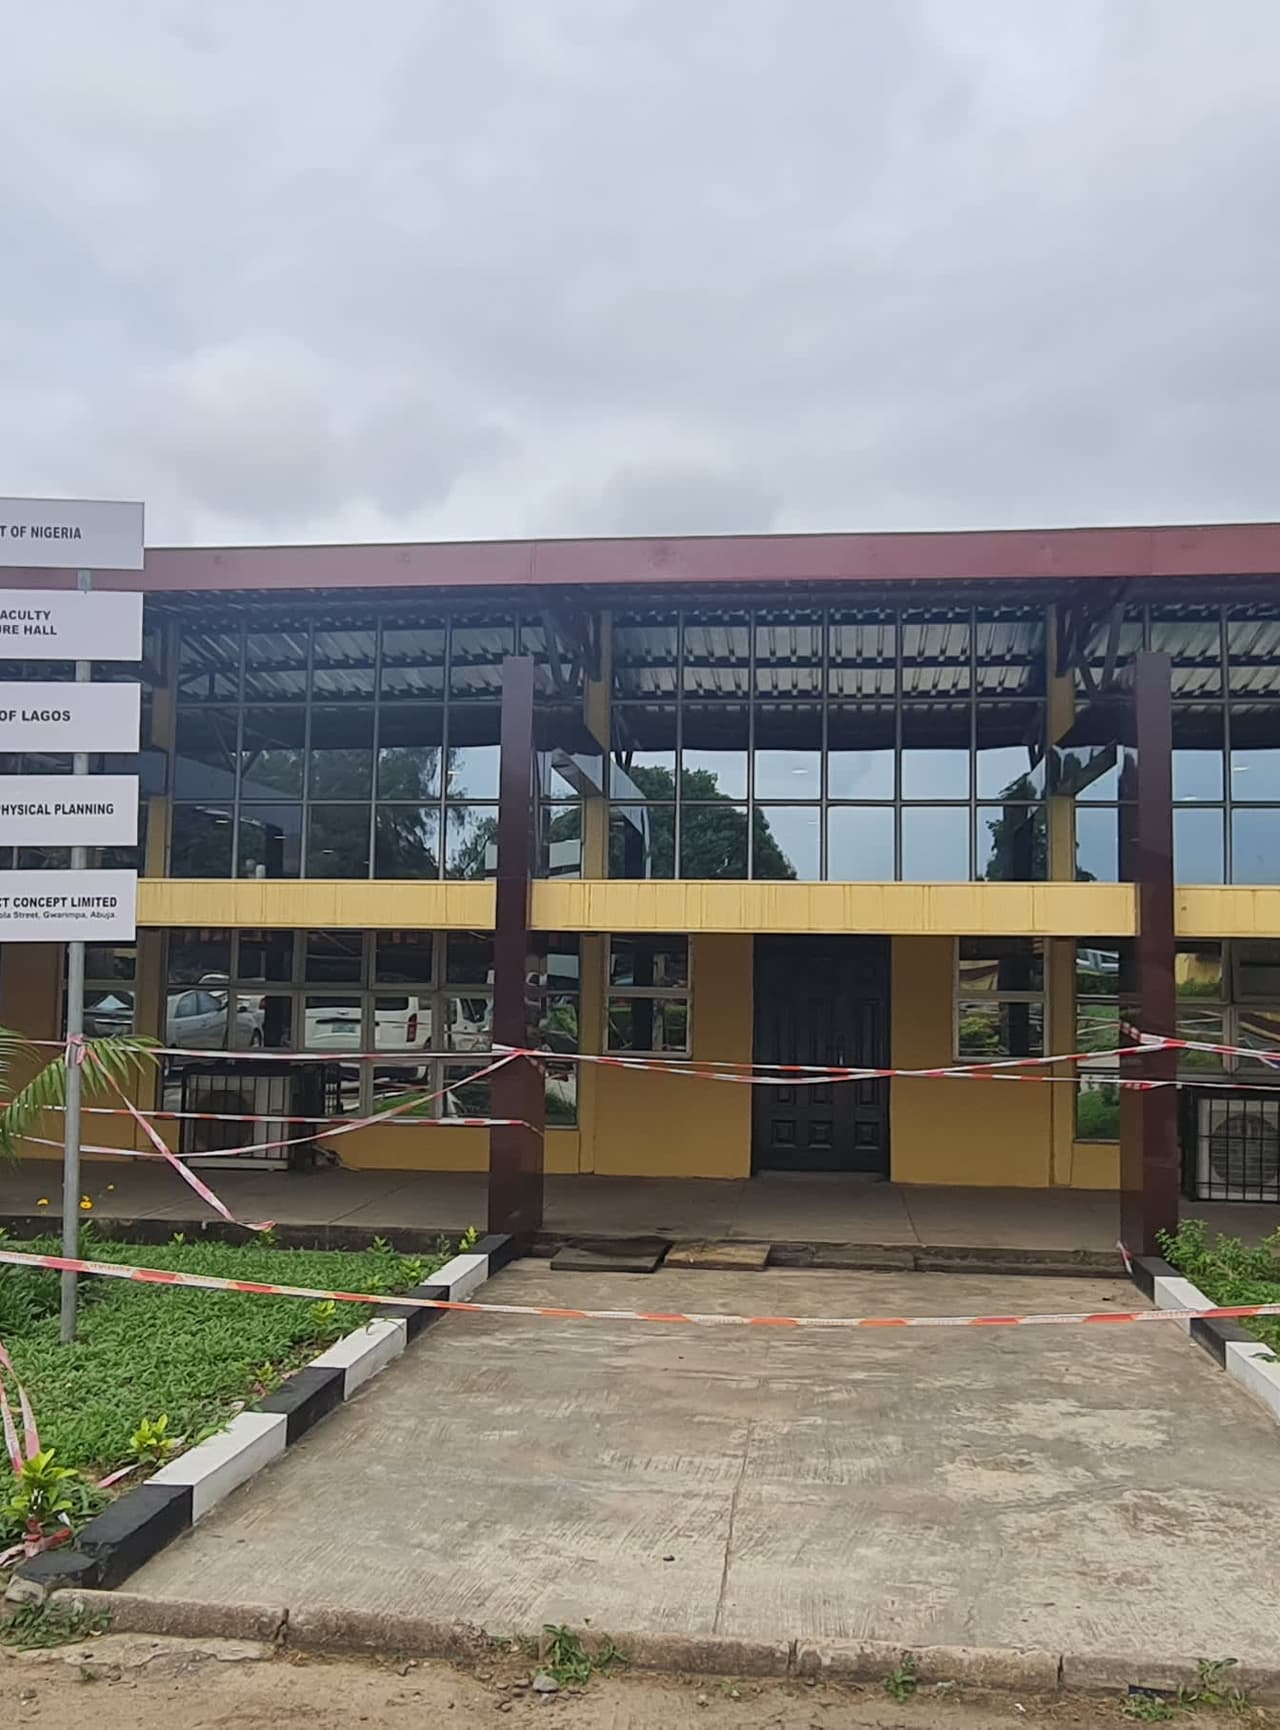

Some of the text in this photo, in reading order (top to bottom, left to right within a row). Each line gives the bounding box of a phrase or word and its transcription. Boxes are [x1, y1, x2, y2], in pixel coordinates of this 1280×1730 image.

[10, 525, 27, 538] OF
[30, 525, 82, 540] NIGERIA
[23, 624, 57, 636] HALL
[21, 710, 71, 722] LAGOS
[54, 803, 114, 815] PLANNING
[12, 896, 68, 908] CONCEPT
[70, 896, 118, 908] LIMITED
